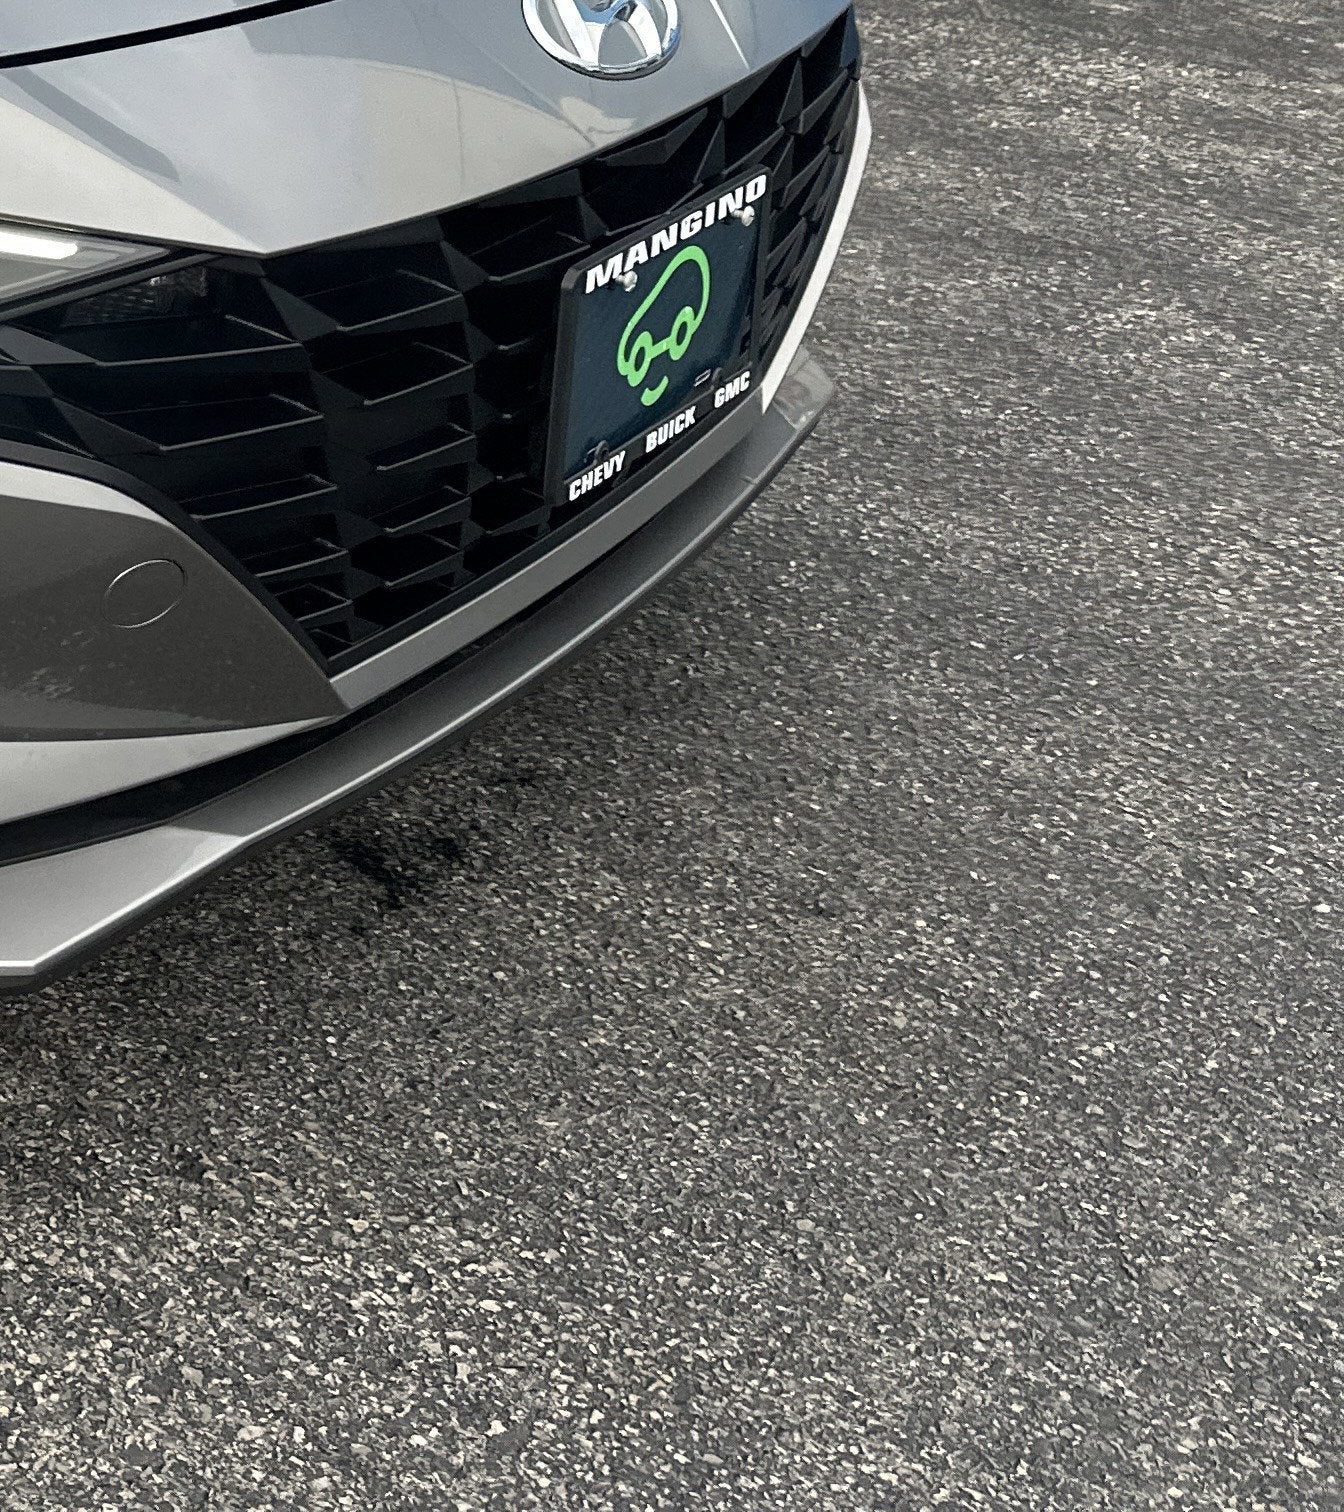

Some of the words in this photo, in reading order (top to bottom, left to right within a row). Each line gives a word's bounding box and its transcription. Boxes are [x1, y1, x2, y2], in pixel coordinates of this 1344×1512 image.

[584, 174, 767, 295] MANGINO
[568, 450, 626, 502] CHEVY
[645, 404, 697, 454] BUICK
[714, 370, 751, 409] GMC
